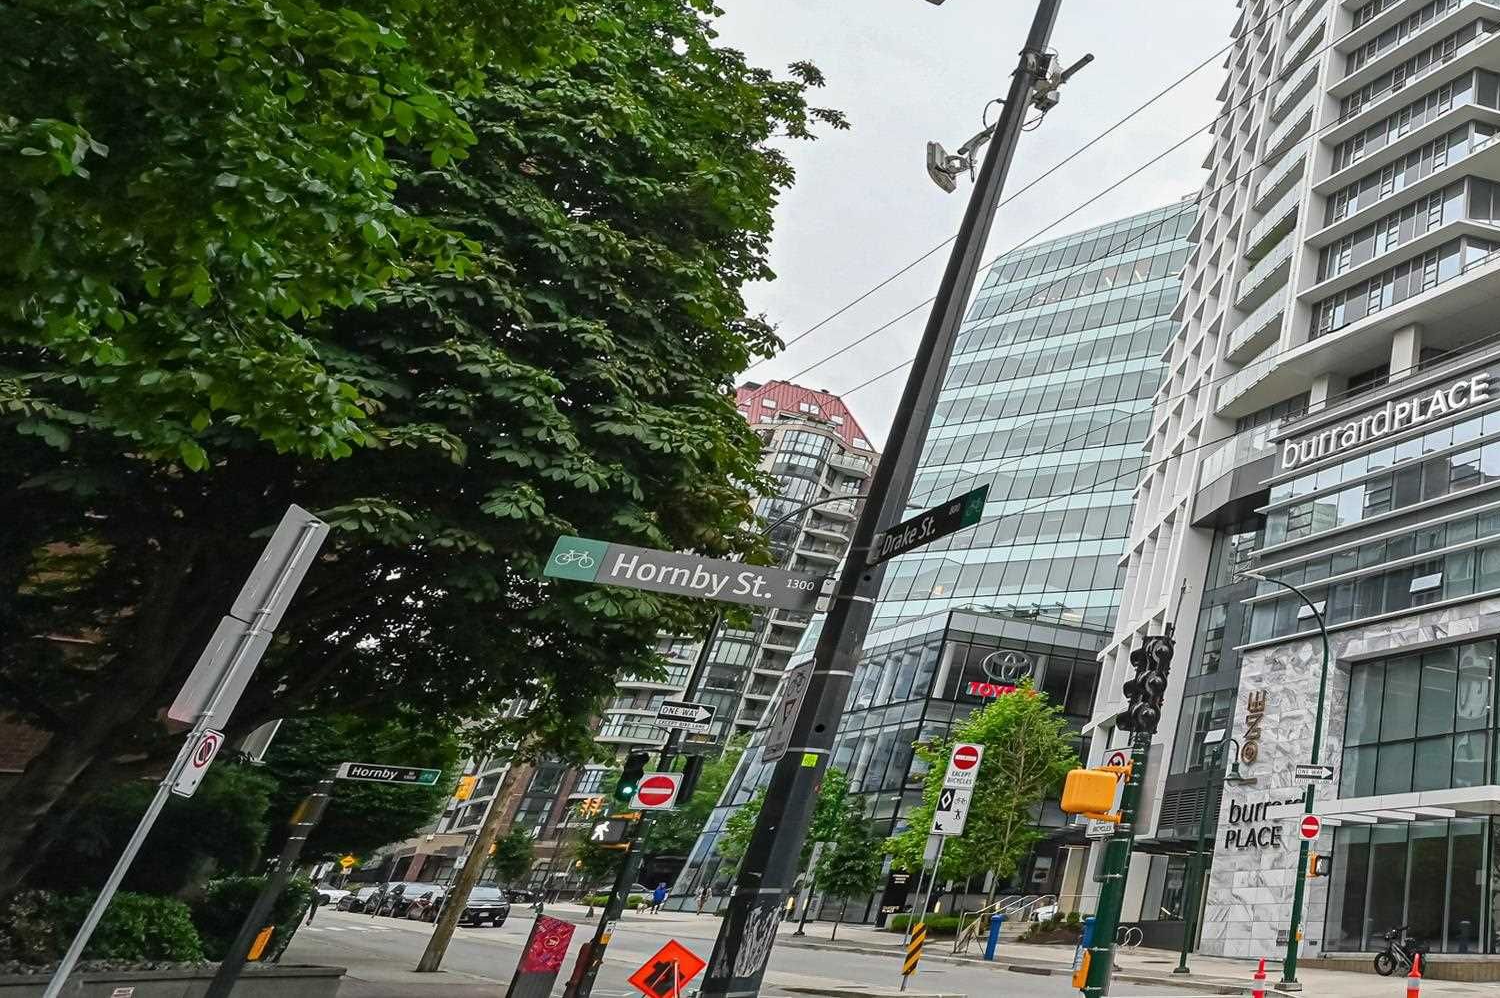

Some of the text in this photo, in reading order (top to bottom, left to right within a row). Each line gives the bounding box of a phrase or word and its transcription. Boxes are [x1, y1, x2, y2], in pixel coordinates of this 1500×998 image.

[881, 516, 936, 556] Drake St.
[610, 553, 773, 600] Hornby St.
[785, 578, 815, 592] 1300
[662, 706, 699, 717] ONE WAY
[1241, 690, 1267, 764] ONE
[351, 767, 398, 780] Hornby
[1229, 792, 1306, 824] burr
[1225, 825, 1283, 850] PLACE
